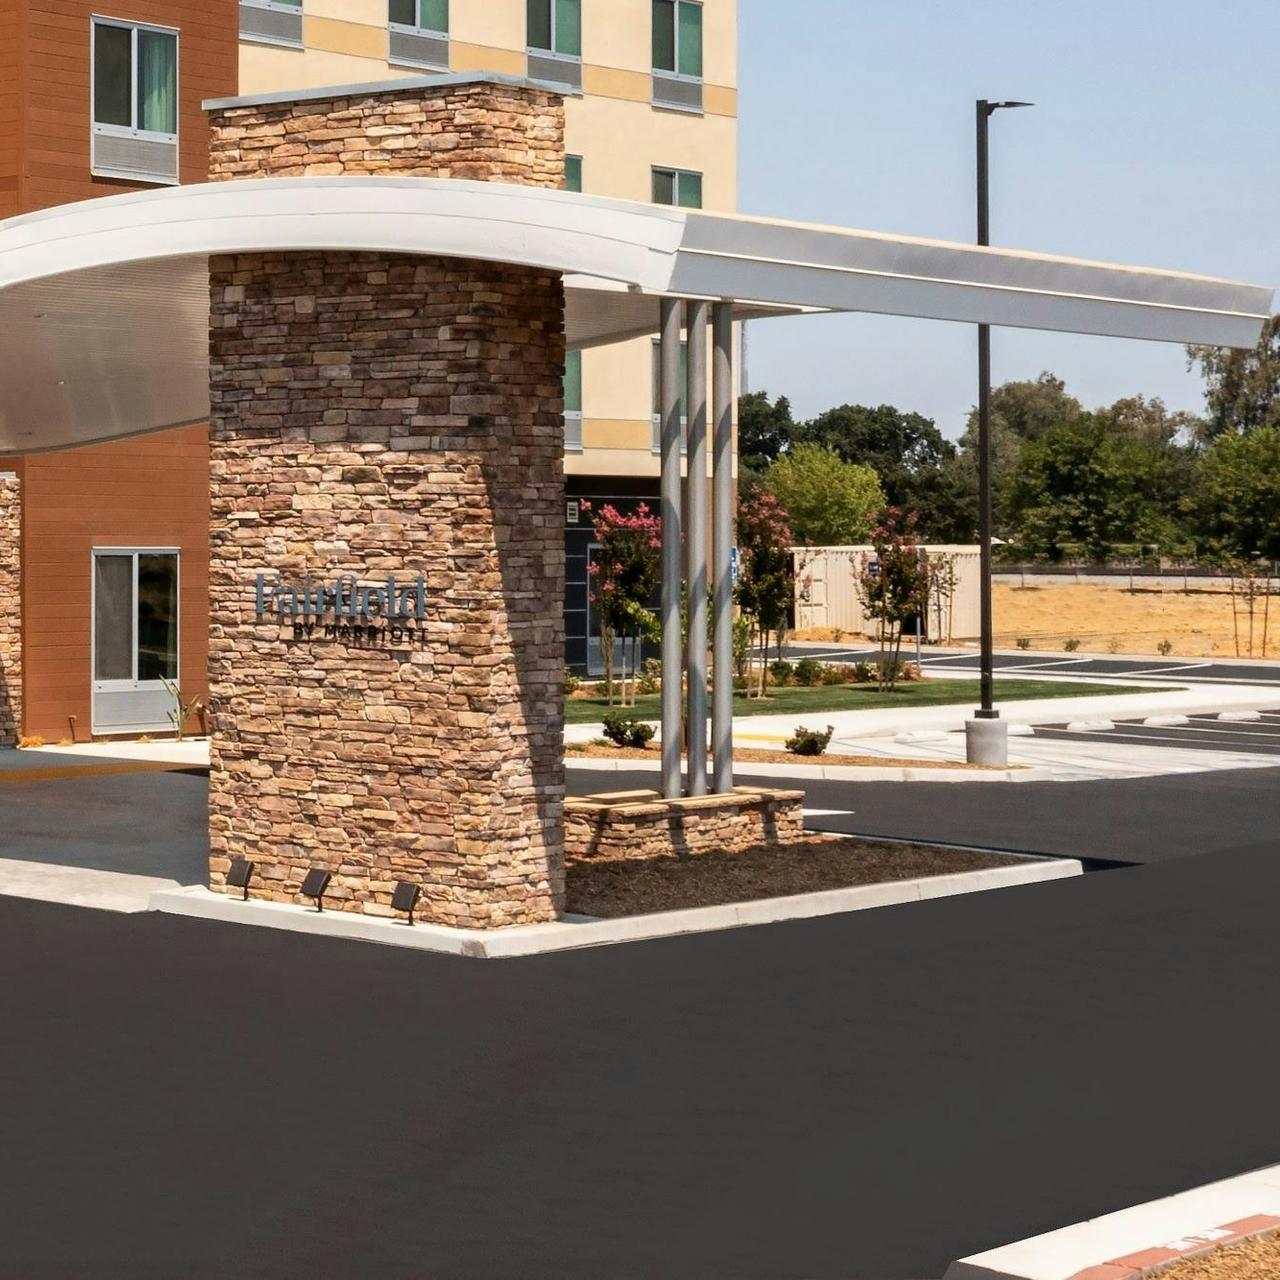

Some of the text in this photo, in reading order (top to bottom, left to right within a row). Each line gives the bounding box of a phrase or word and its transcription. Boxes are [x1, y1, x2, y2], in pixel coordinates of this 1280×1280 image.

[255, 573, 426, 619] Fairfield
[293, 622, 429, 646] BY MARRIOTT
